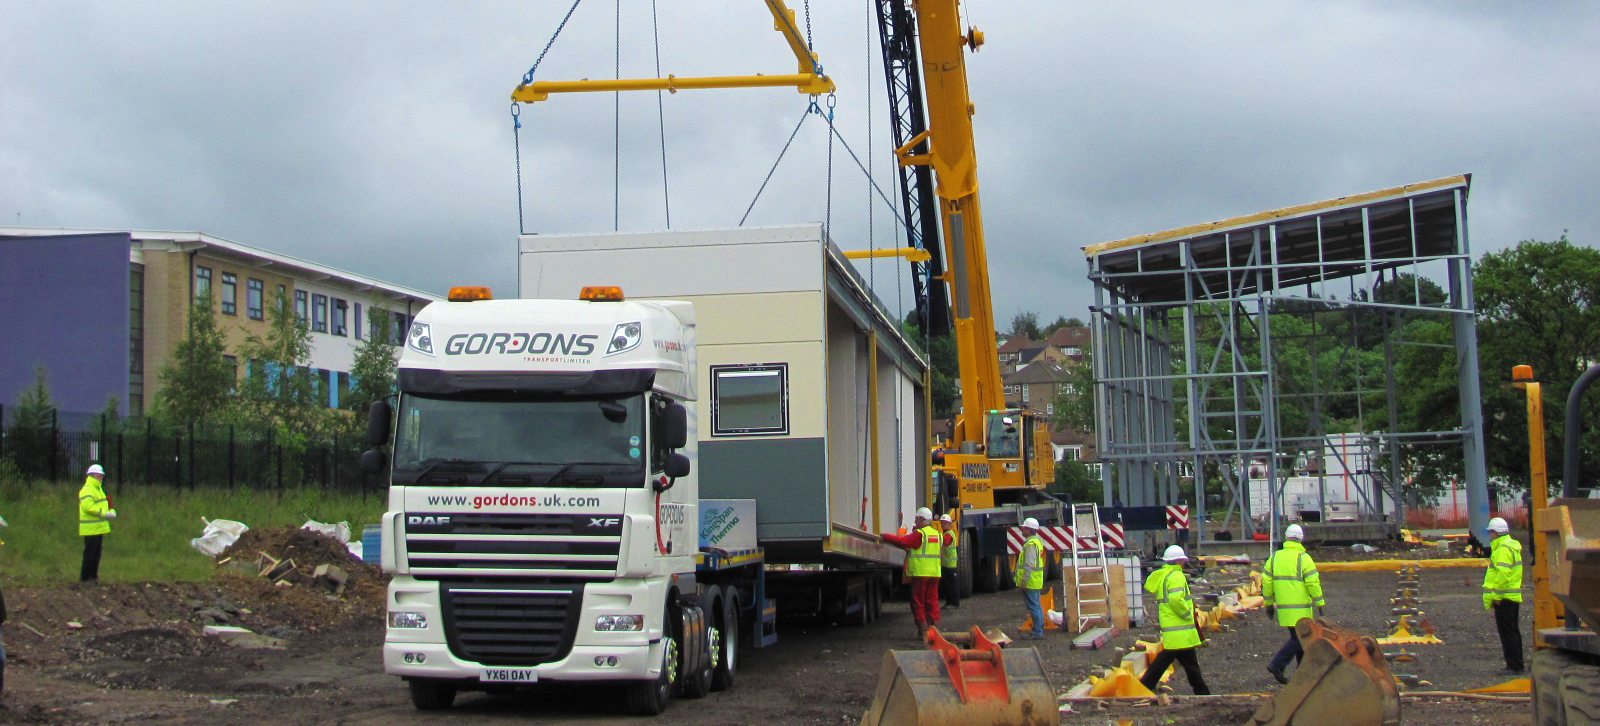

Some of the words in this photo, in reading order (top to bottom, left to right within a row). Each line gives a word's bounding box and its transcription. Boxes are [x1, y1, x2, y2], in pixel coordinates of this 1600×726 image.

[445, 332, 599, 356] GORDONS
[428, 493, 600, 509] www.gordons.uk.com
[408, 516, 450, 525] DAF
[587, 517, 620, 527] XF
[660, 504, 685, 525] GORDONS
[700, 506, 734, 540] Kingspan
[710, 516, 740, 545] Therma
[486, 670, 509, 680] YX61
